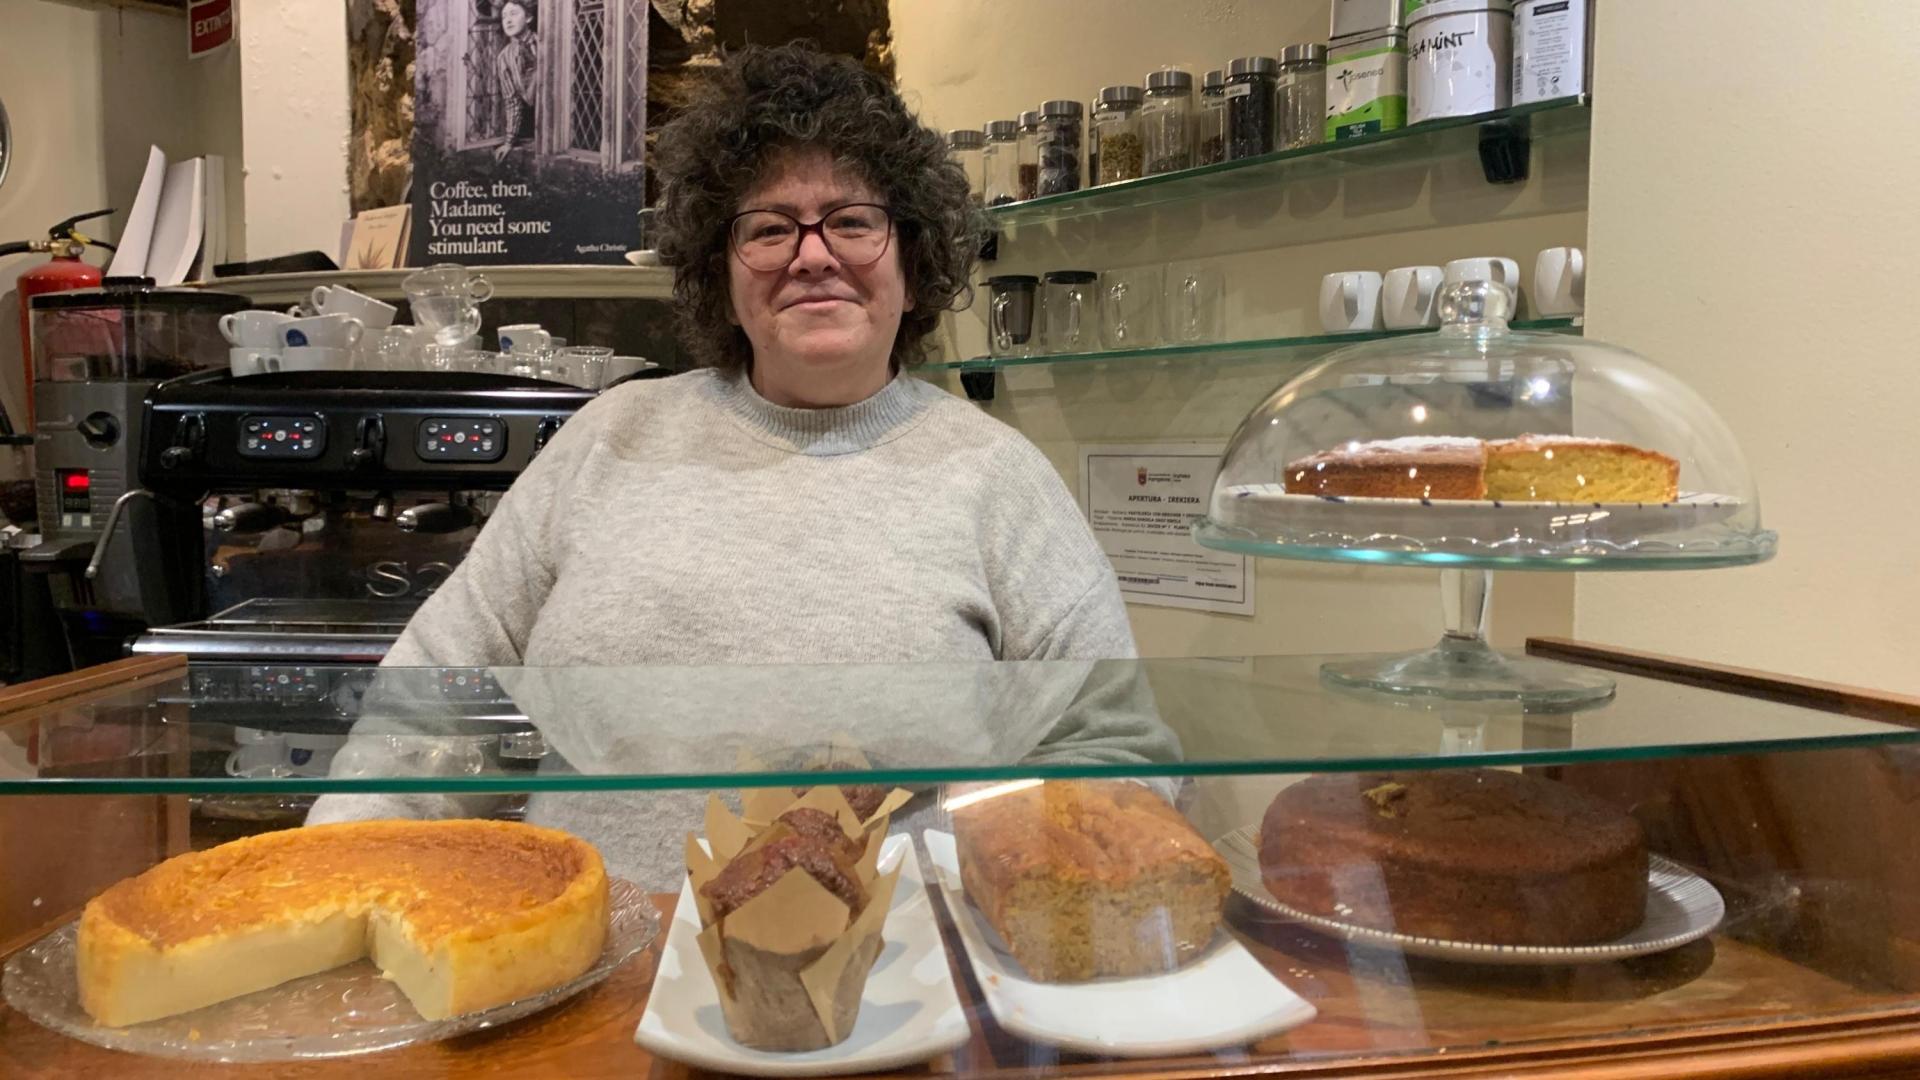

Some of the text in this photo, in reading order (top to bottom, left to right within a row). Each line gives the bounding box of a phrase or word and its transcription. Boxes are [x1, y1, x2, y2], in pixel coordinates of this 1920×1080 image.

[430, 180, 532, 199] Coffee, then,
[429, 200, 506, 218] Madame.
[429, 217, 551, 237] You need some
[427, 238, 508, 255] stimulant.
[575, 243, 628, 254] Agatha Christie
[1128, 495, 1162, 503] APERTURA
